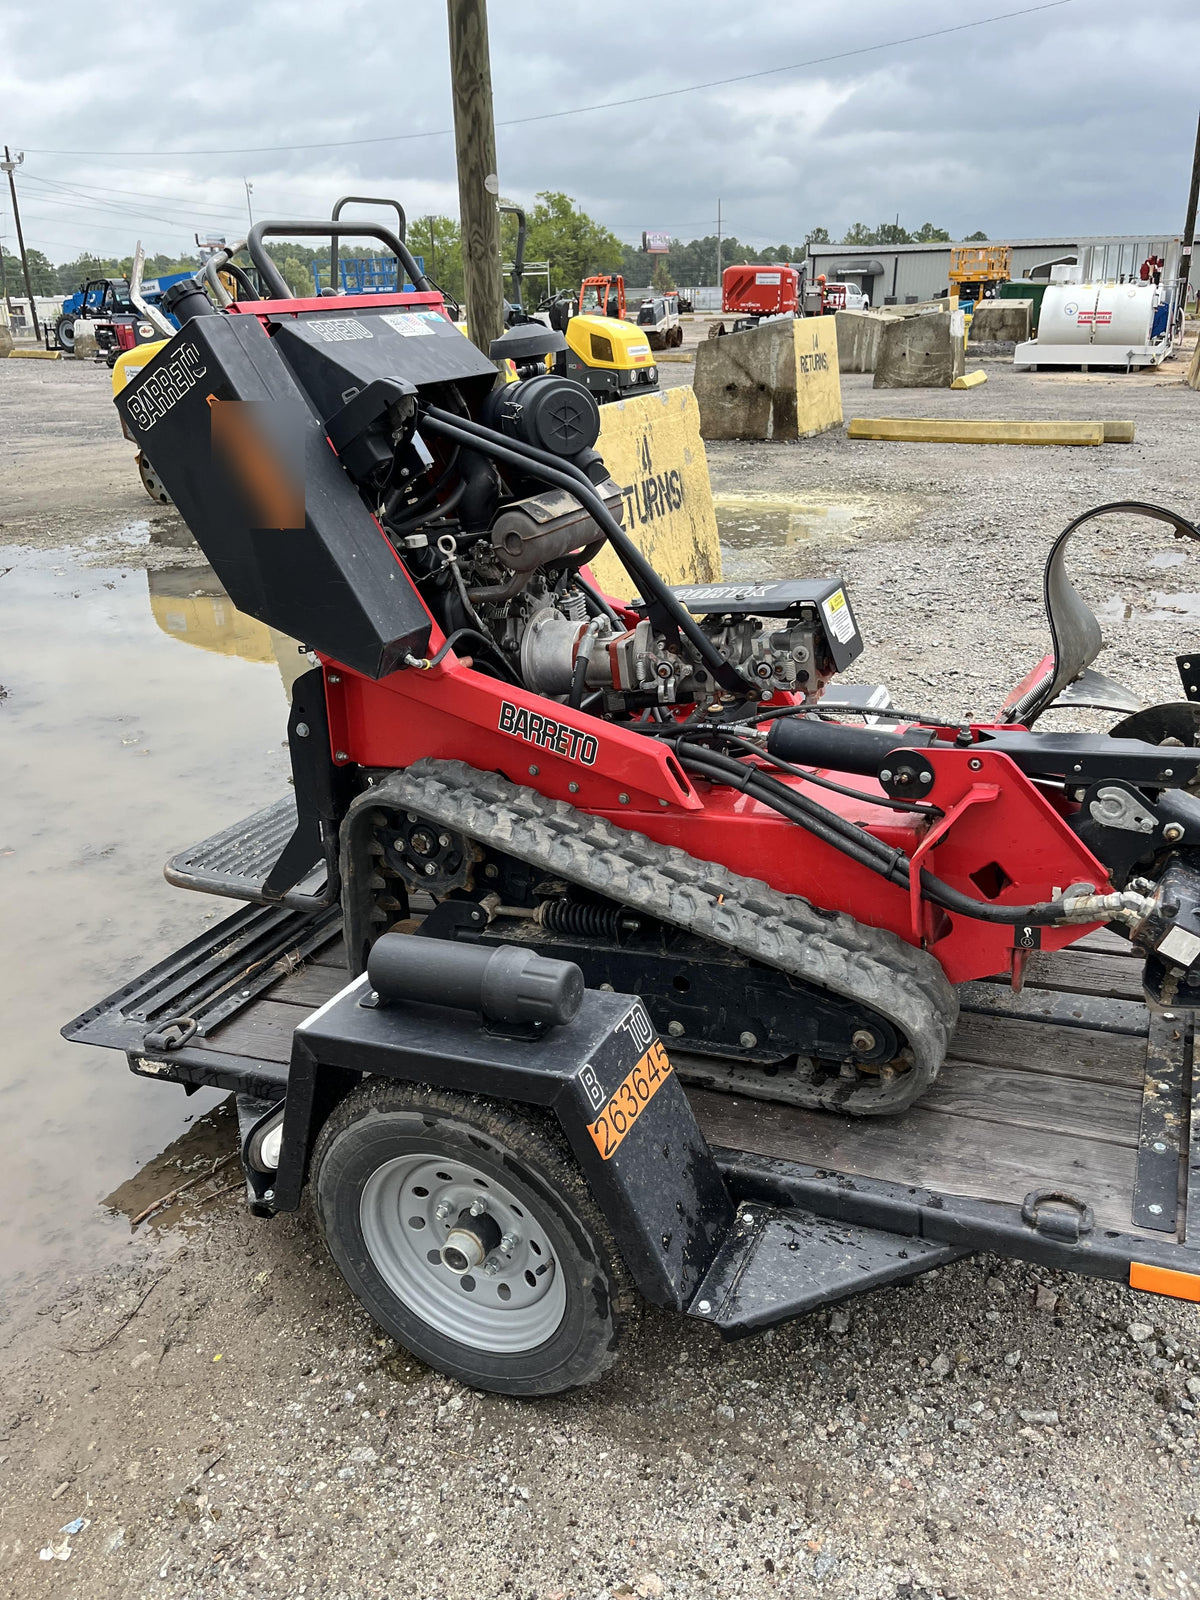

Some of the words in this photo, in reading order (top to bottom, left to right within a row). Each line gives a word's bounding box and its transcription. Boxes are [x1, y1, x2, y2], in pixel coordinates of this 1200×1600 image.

[126, 342, 207, 431] BARRETO
[800, 352, 829, 373] RETURNS
[620, 468, 683, 533] TURNS
[497, 700, 600, 767] BARRETO
[578, 1063, 606, 1111] B
[594, 1040, 671, 1157] 263645
